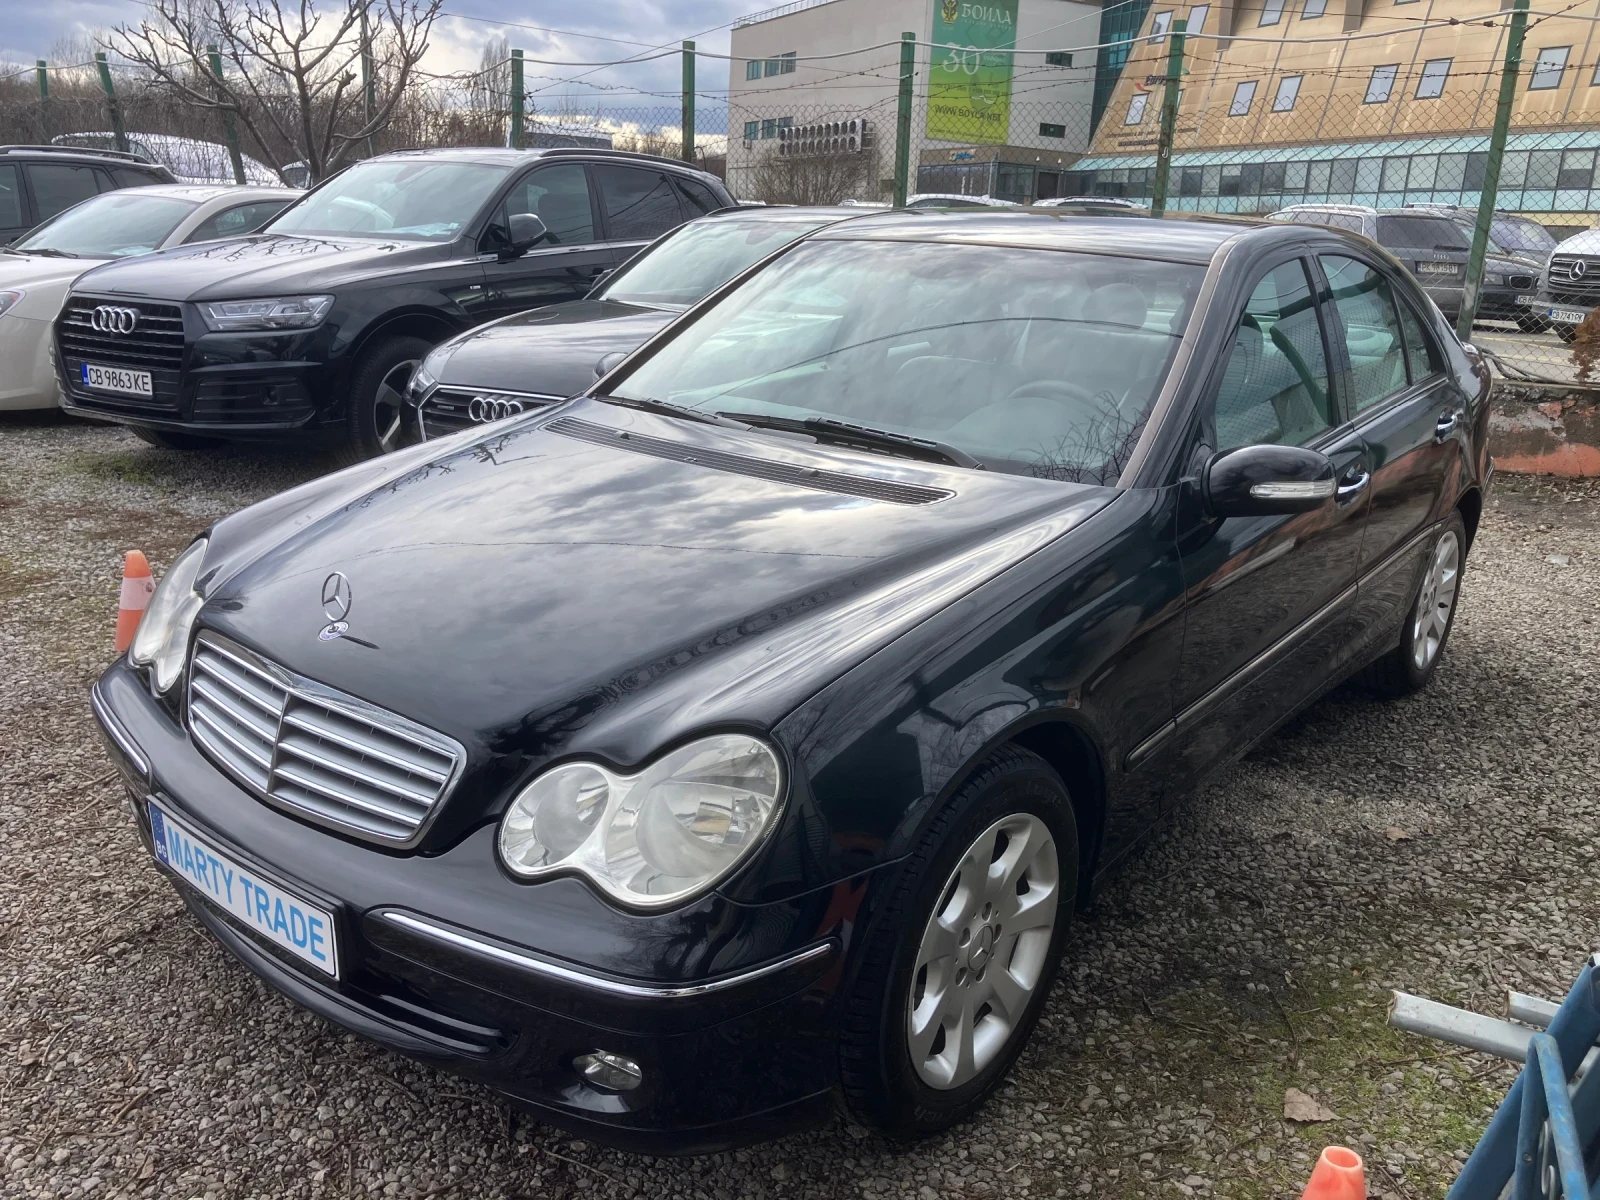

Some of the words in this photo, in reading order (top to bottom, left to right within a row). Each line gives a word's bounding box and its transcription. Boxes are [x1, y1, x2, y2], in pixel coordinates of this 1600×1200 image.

[941, 42, 980, 75] 30
[88, 368, 103, 385] CB
[104, 370, 132, 389] 9863
[133, 373, 151, 392] KE
[155, 839, 168, 859] BG
[167, 825, 234, 905] MARTY
[239, 875, 327, 963] TRADE
